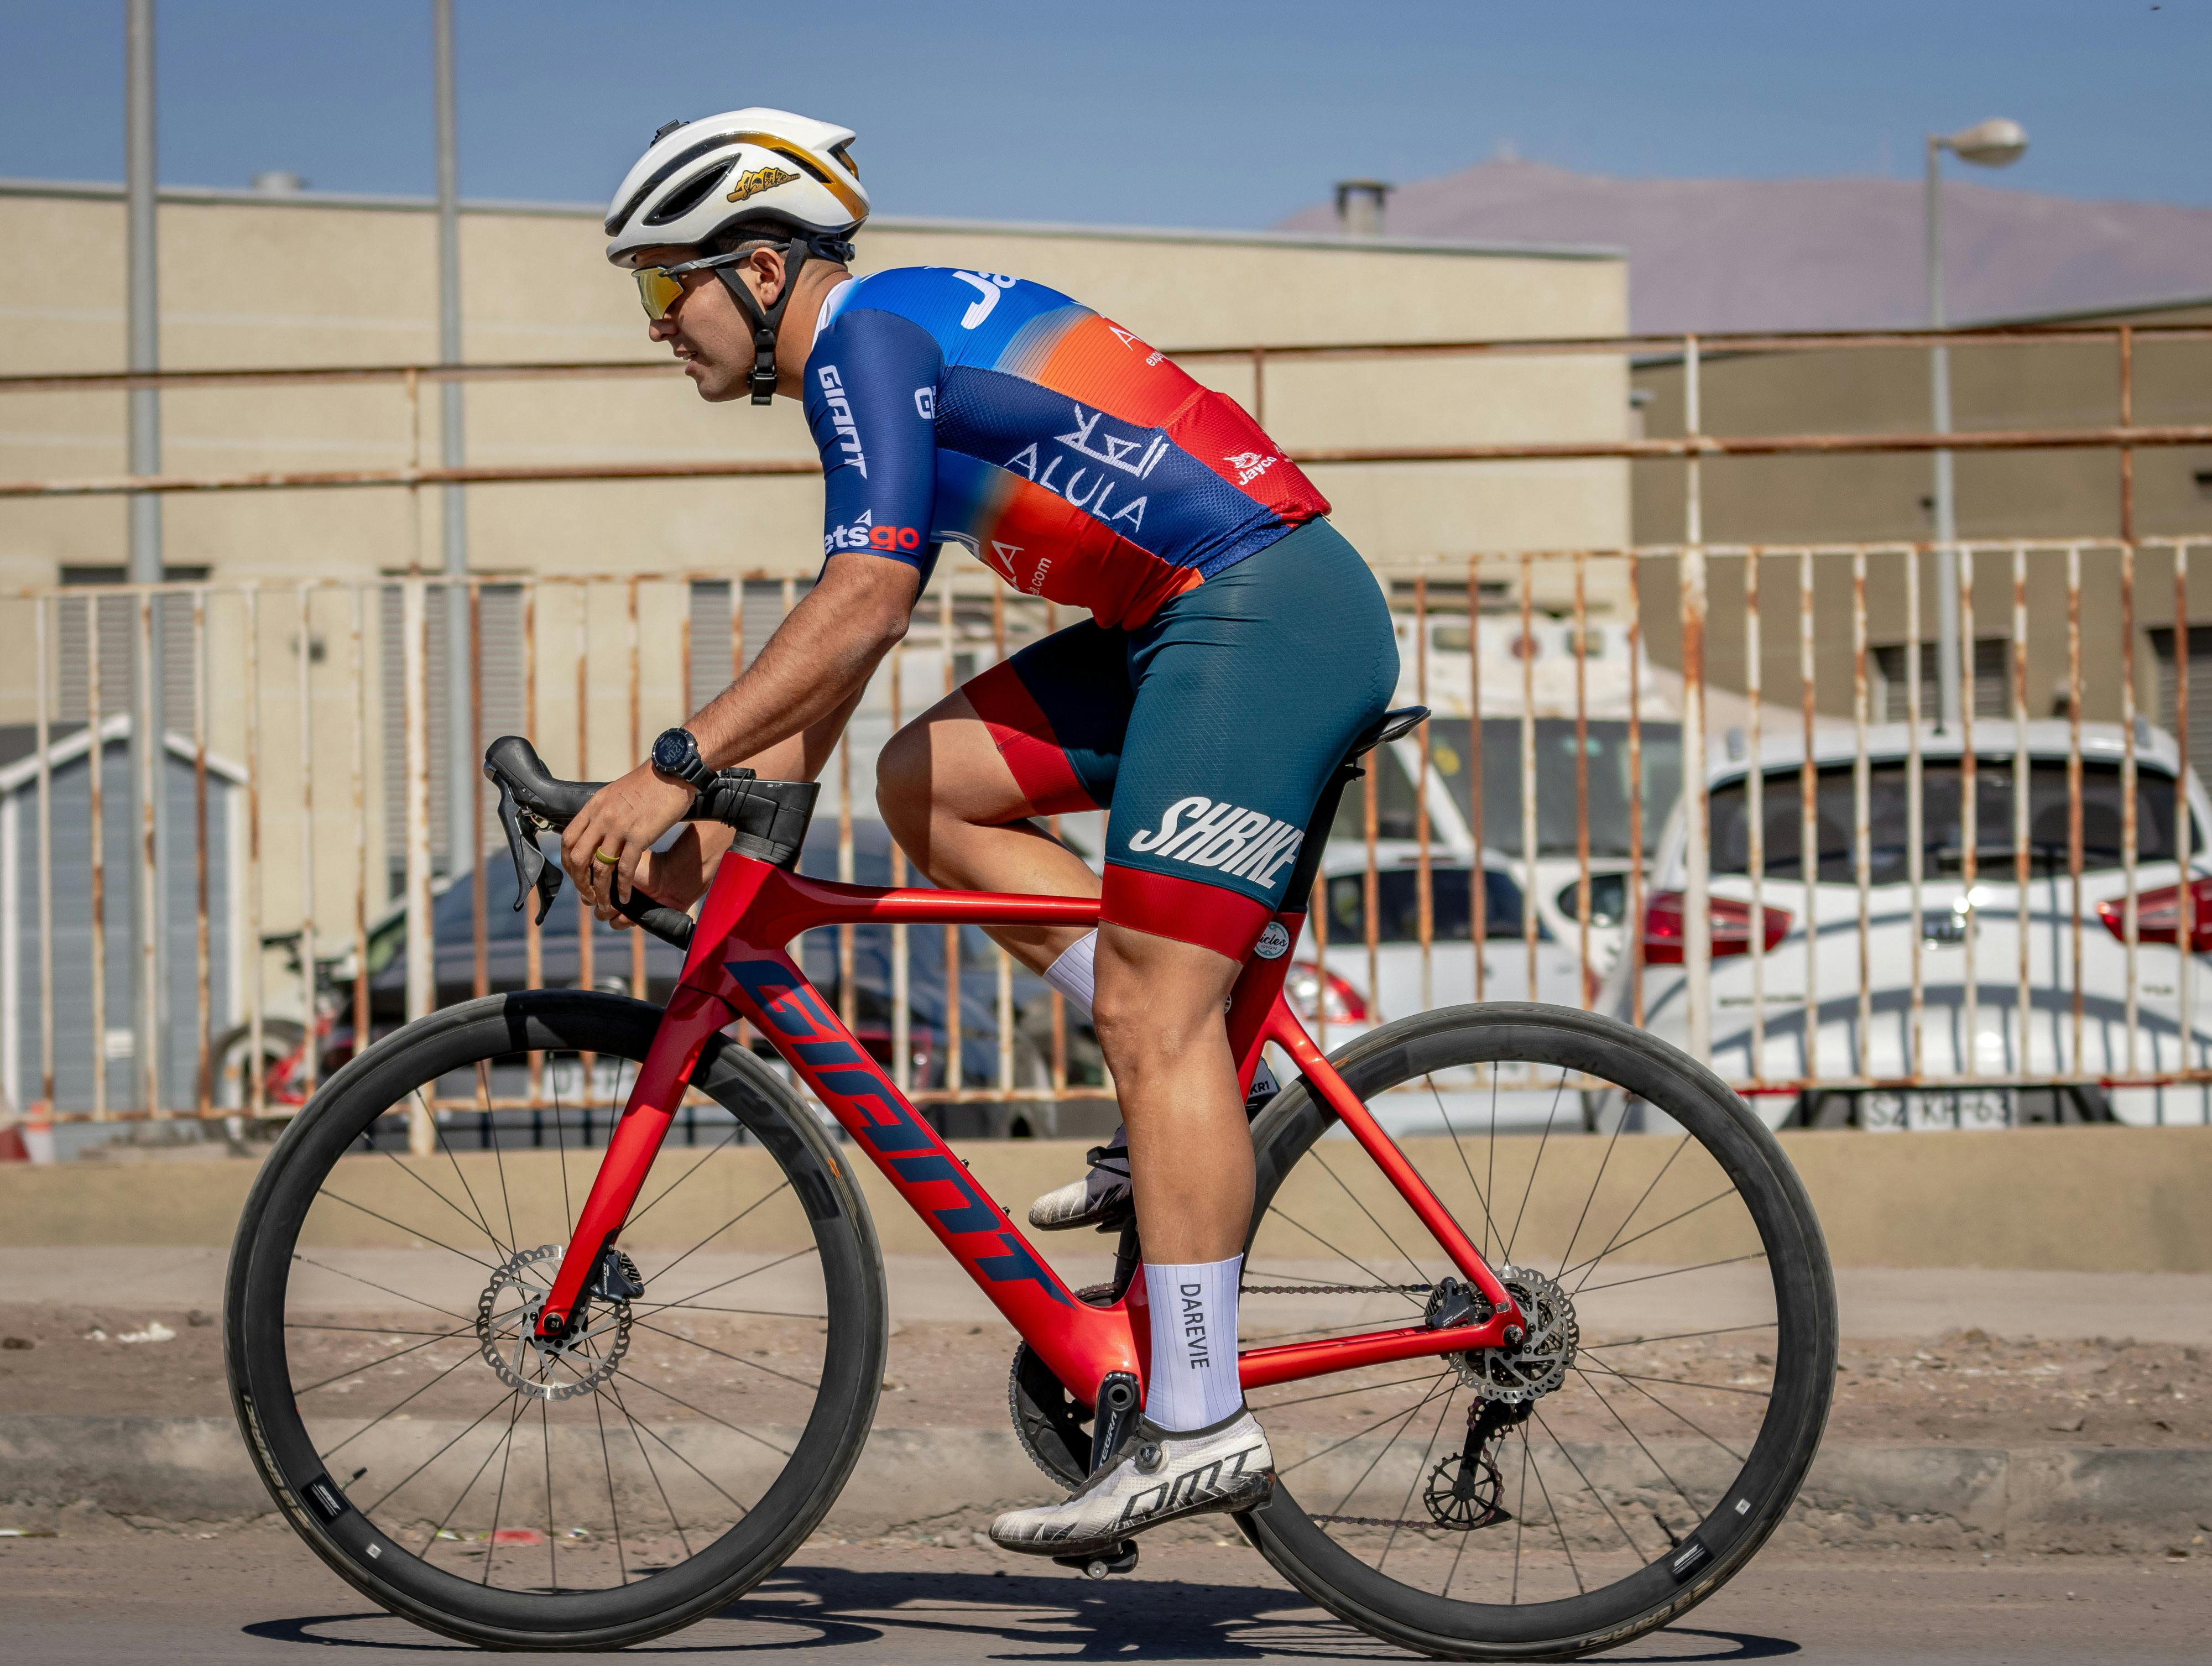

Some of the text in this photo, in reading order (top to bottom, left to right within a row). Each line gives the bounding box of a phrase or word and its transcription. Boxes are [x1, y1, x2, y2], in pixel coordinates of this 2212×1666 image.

[818, 365, 867, 479] GIANT
[1004, 442, 1147, 533] ALULA
[1239, 456, 1277, 486] Jayco
[1129, 796, 1305, 889] SHBIKE
[723, 960, 1077, 1310] GIANT
[1180, 1283, 1209, 1370] DAREVIE
